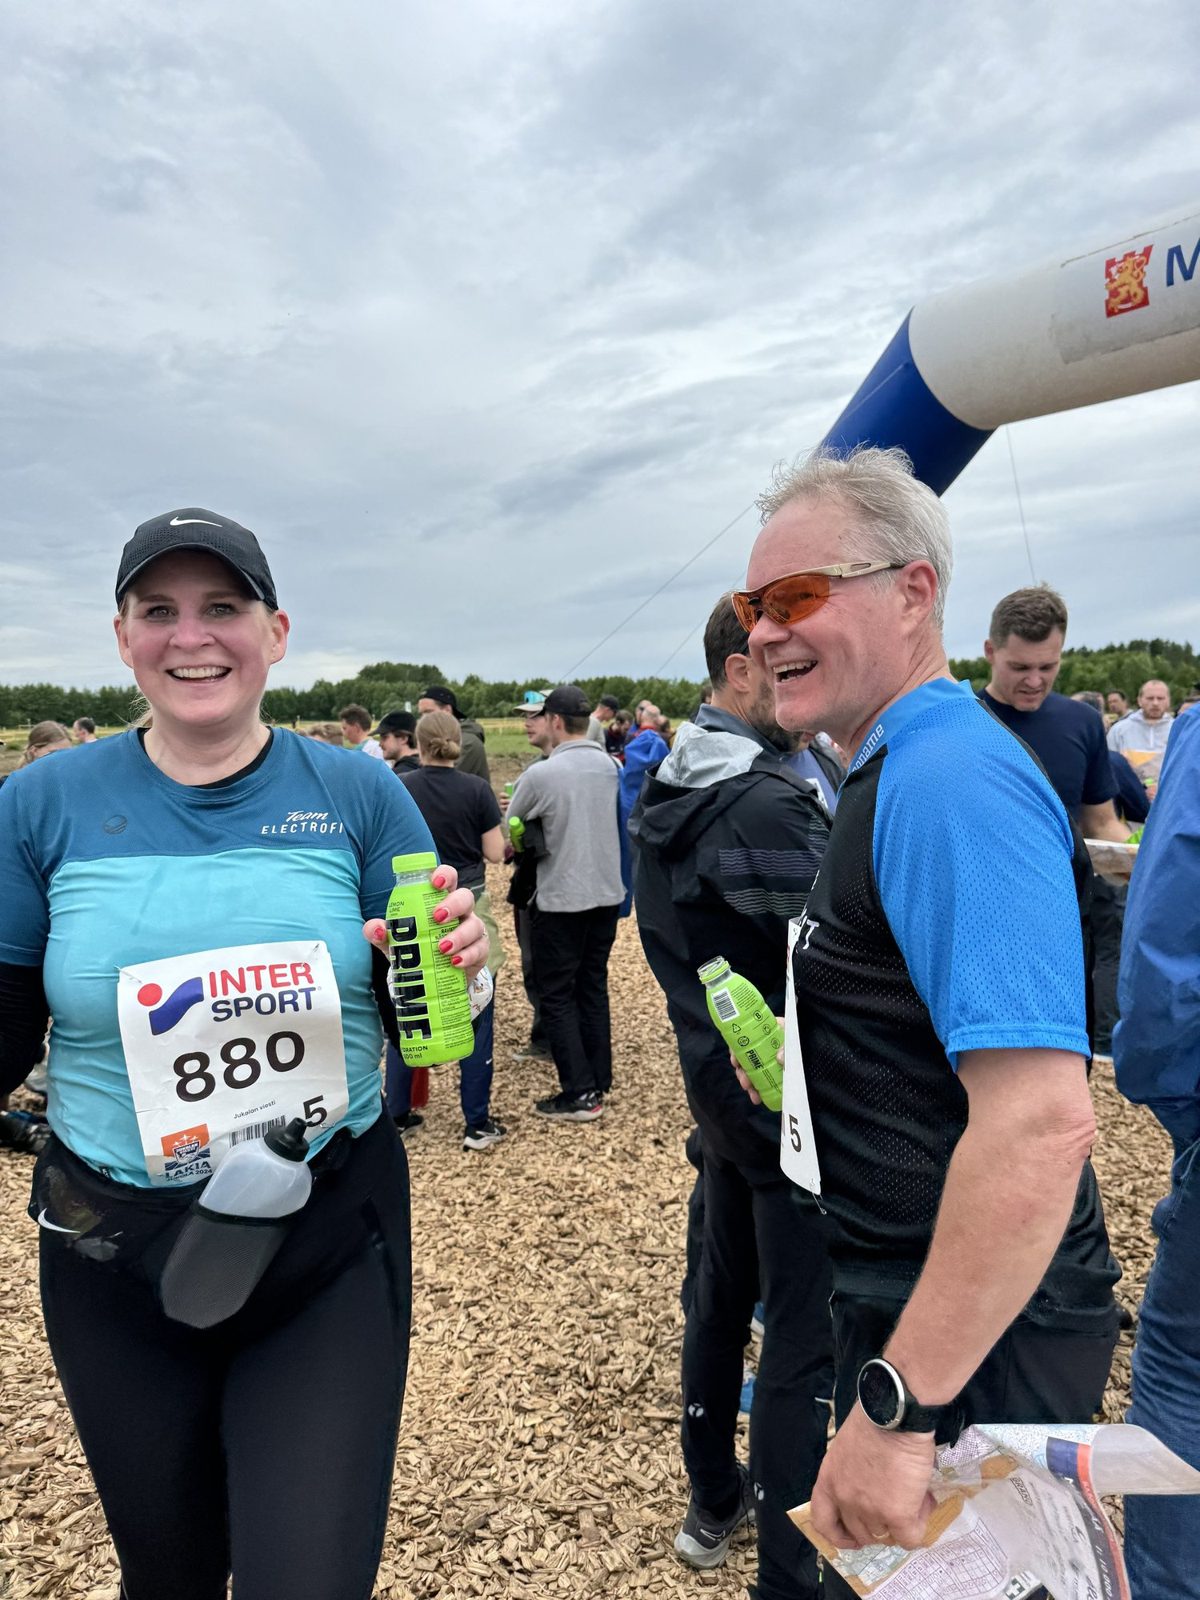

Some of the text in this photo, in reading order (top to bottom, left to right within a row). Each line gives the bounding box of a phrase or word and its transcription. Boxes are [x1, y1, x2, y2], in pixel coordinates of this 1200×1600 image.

[1166, 237, 1200, 287] M
[261, 821, 343, 834] ELECTROFI
[286, 811, 328, 822] Team
[209, 962, 314, 998] INTER
[386, 916, 432, 1039] PRIME
[211, 987, 316, 1022] SPORT
[173, 1030, 305, 1102] 880
[746, 1049, 764, 1070] PRIME
[303, 1095, 327, 1127] 5
[789, 1114, 801, 1153] 5
[165, 1161, 211, 1178] LAKIA
